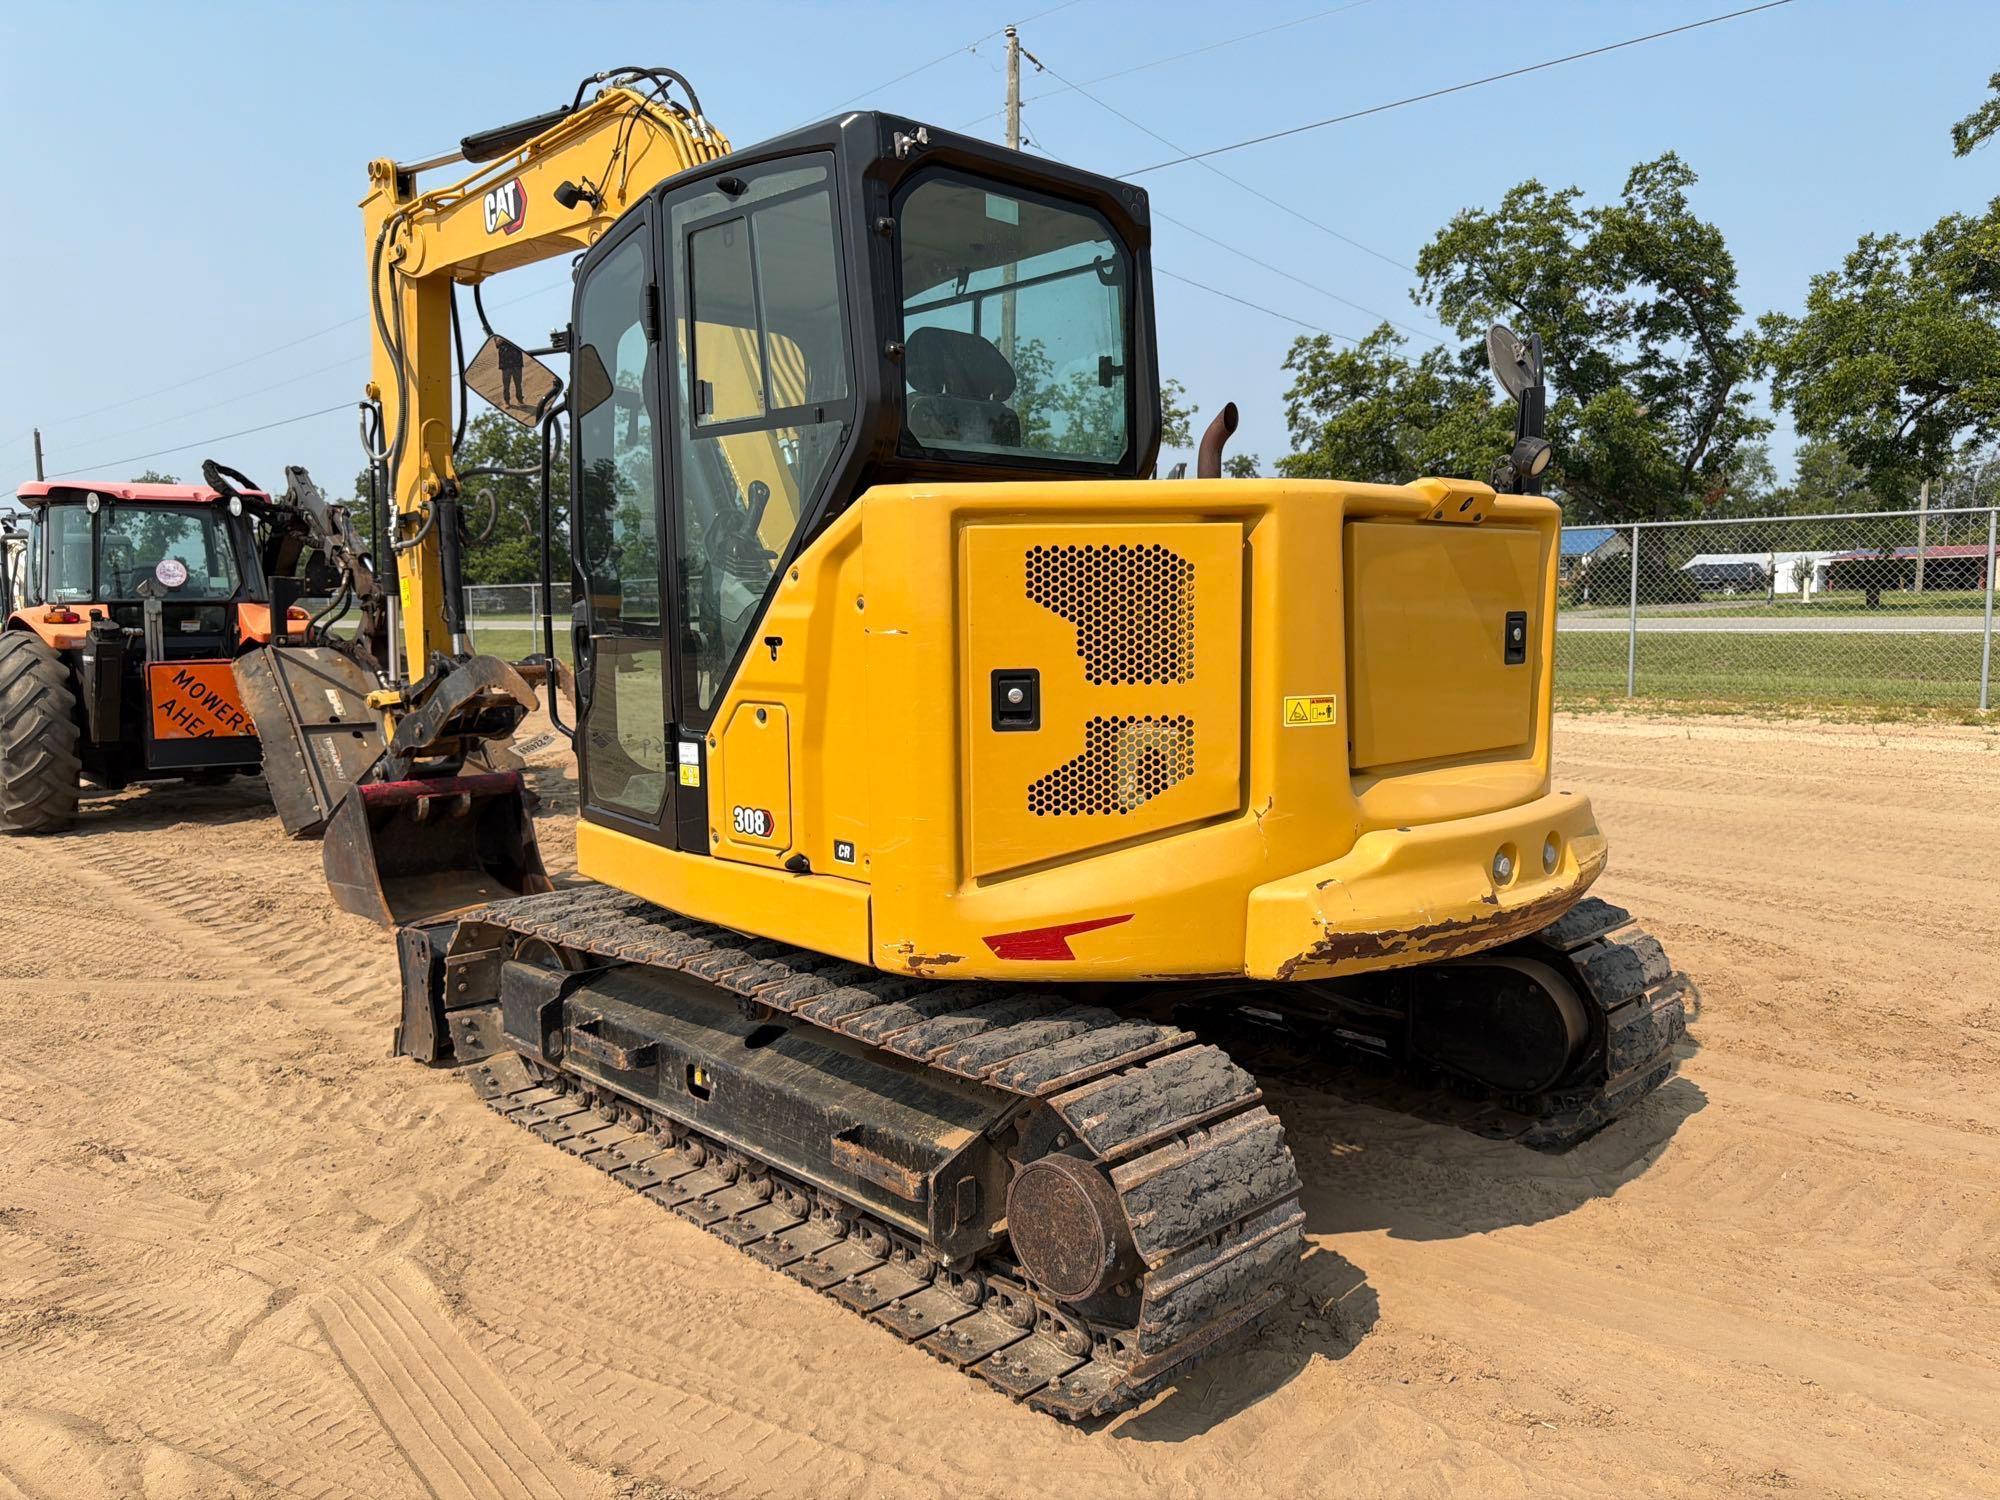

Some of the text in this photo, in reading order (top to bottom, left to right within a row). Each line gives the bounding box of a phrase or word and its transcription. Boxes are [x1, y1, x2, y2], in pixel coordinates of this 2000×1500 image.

[484, 179, 516, 233] CAT
[733, 806, 765, 835] 308
[837, 843, 851, 859] CR
